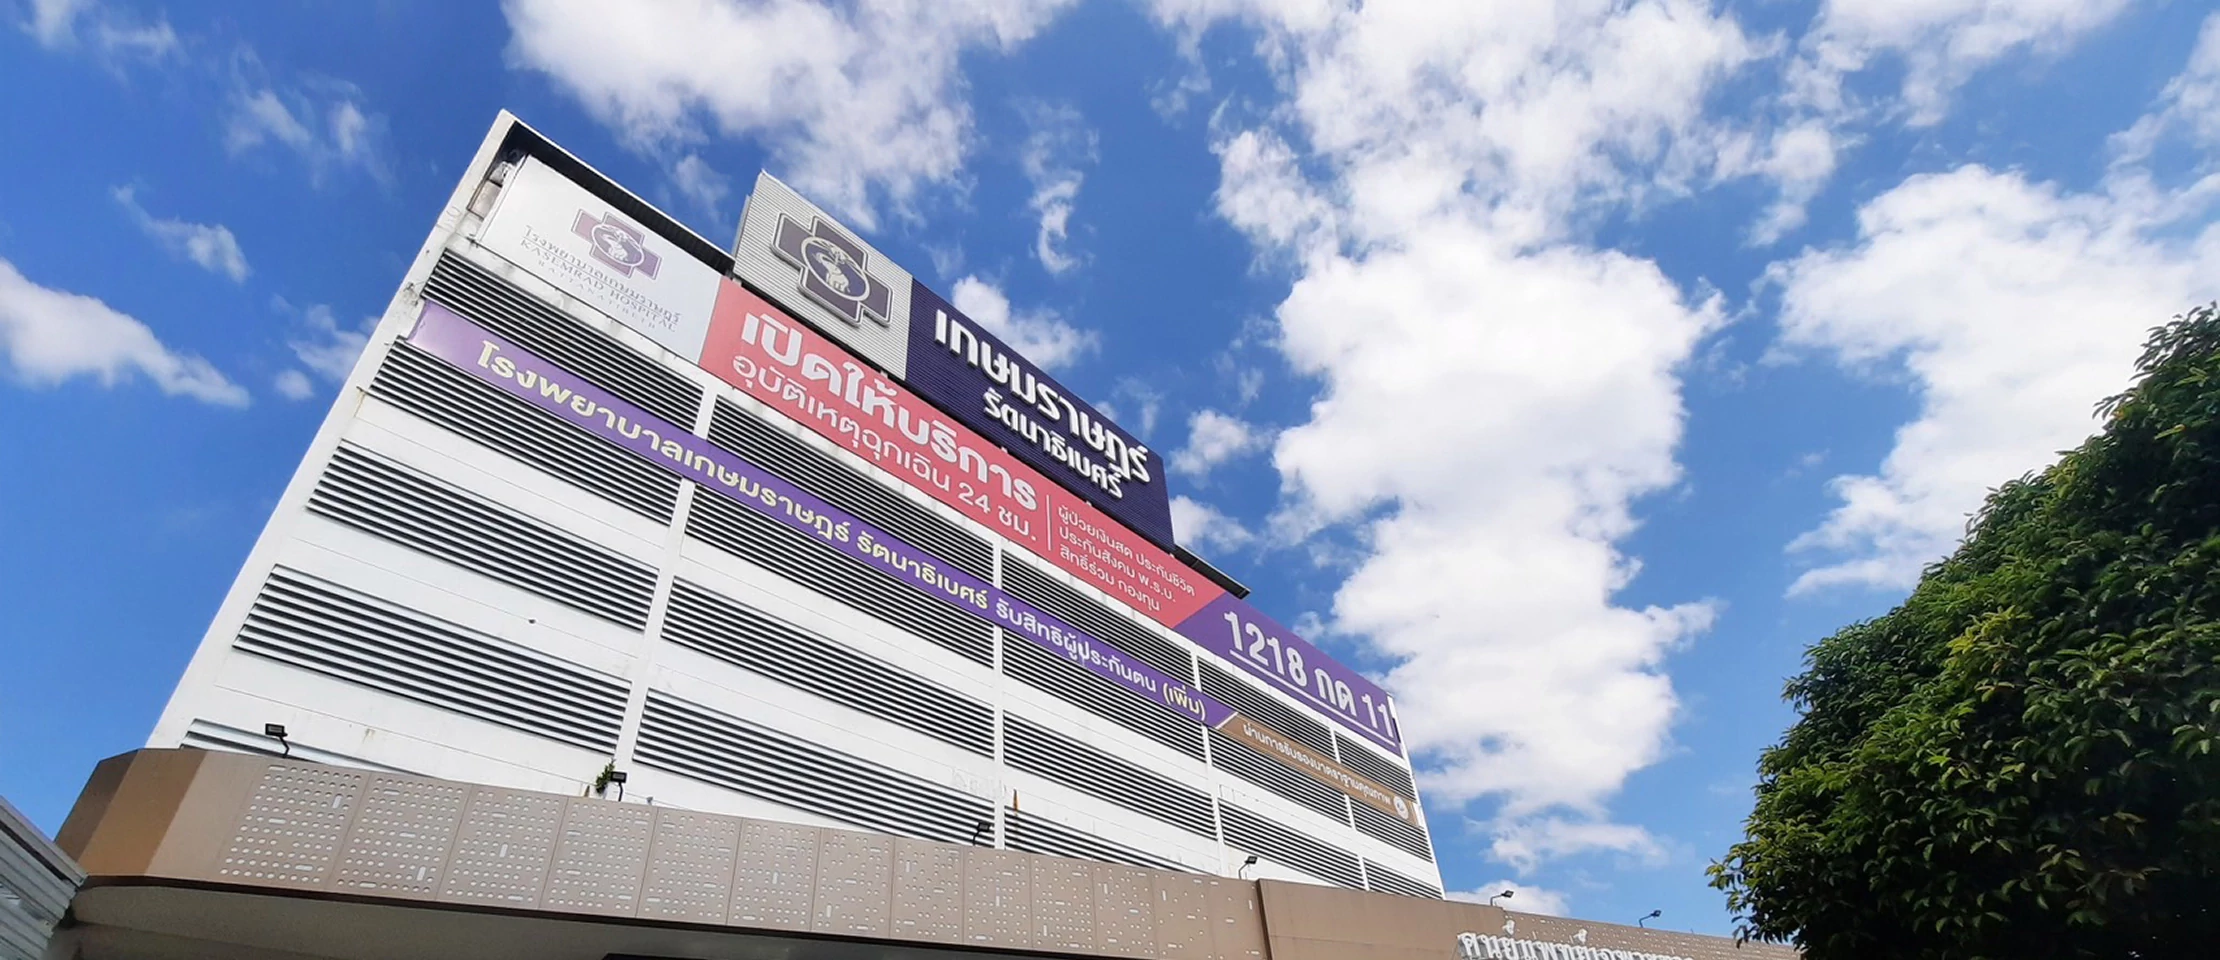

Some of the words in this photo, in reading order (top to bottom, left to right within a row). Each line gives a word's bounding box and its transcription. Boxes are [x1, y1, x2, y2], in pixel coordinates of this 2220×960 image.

[520, 239, 604, 290] KASEMRAD
[610, 290, 676, 333] HOSPITAL
[733, 355, 951, 491] อุบัติเหตุฉุกเฉิน
[958, 482, 991, 514] 24
[998, 505, 1037, 541] ชม.
[741, 312, 1038, 511] เปิดให้บริการ
[935, 309, 1150, 482] เกษมราษฎร์
[983, 387, 1123, 499] รัตนาธิเบศร์
[477, 339, 851, 543] โรงพยาบาลเกษมราษฎร์
[857, 530, 988, 609] รัตนาธิเบศร์
[996, 598, 1157, 693] รับสิทธิผู้ประกันตน
[1163, 683, 1206, 721] (เพิ่ม)
[1058, 505, 1133, 560] ผู้ป่วยเงินสด
[1136, 553, 1196, 597] ประกันชีวิต
[1059, 526, 1136, 578] ประกันสังคม
[1138, 572, 1177, 602] พ.ร.บ.
[1060, 543, 1115, 586] สิทธิ์ร่วม
[1118, 580, 1161, 612] กองทุน
[1224, 611, 1307, 687] 1218
[1315, 668, 1357, 717] กด
[1362, 693, 1394, 738] 11
